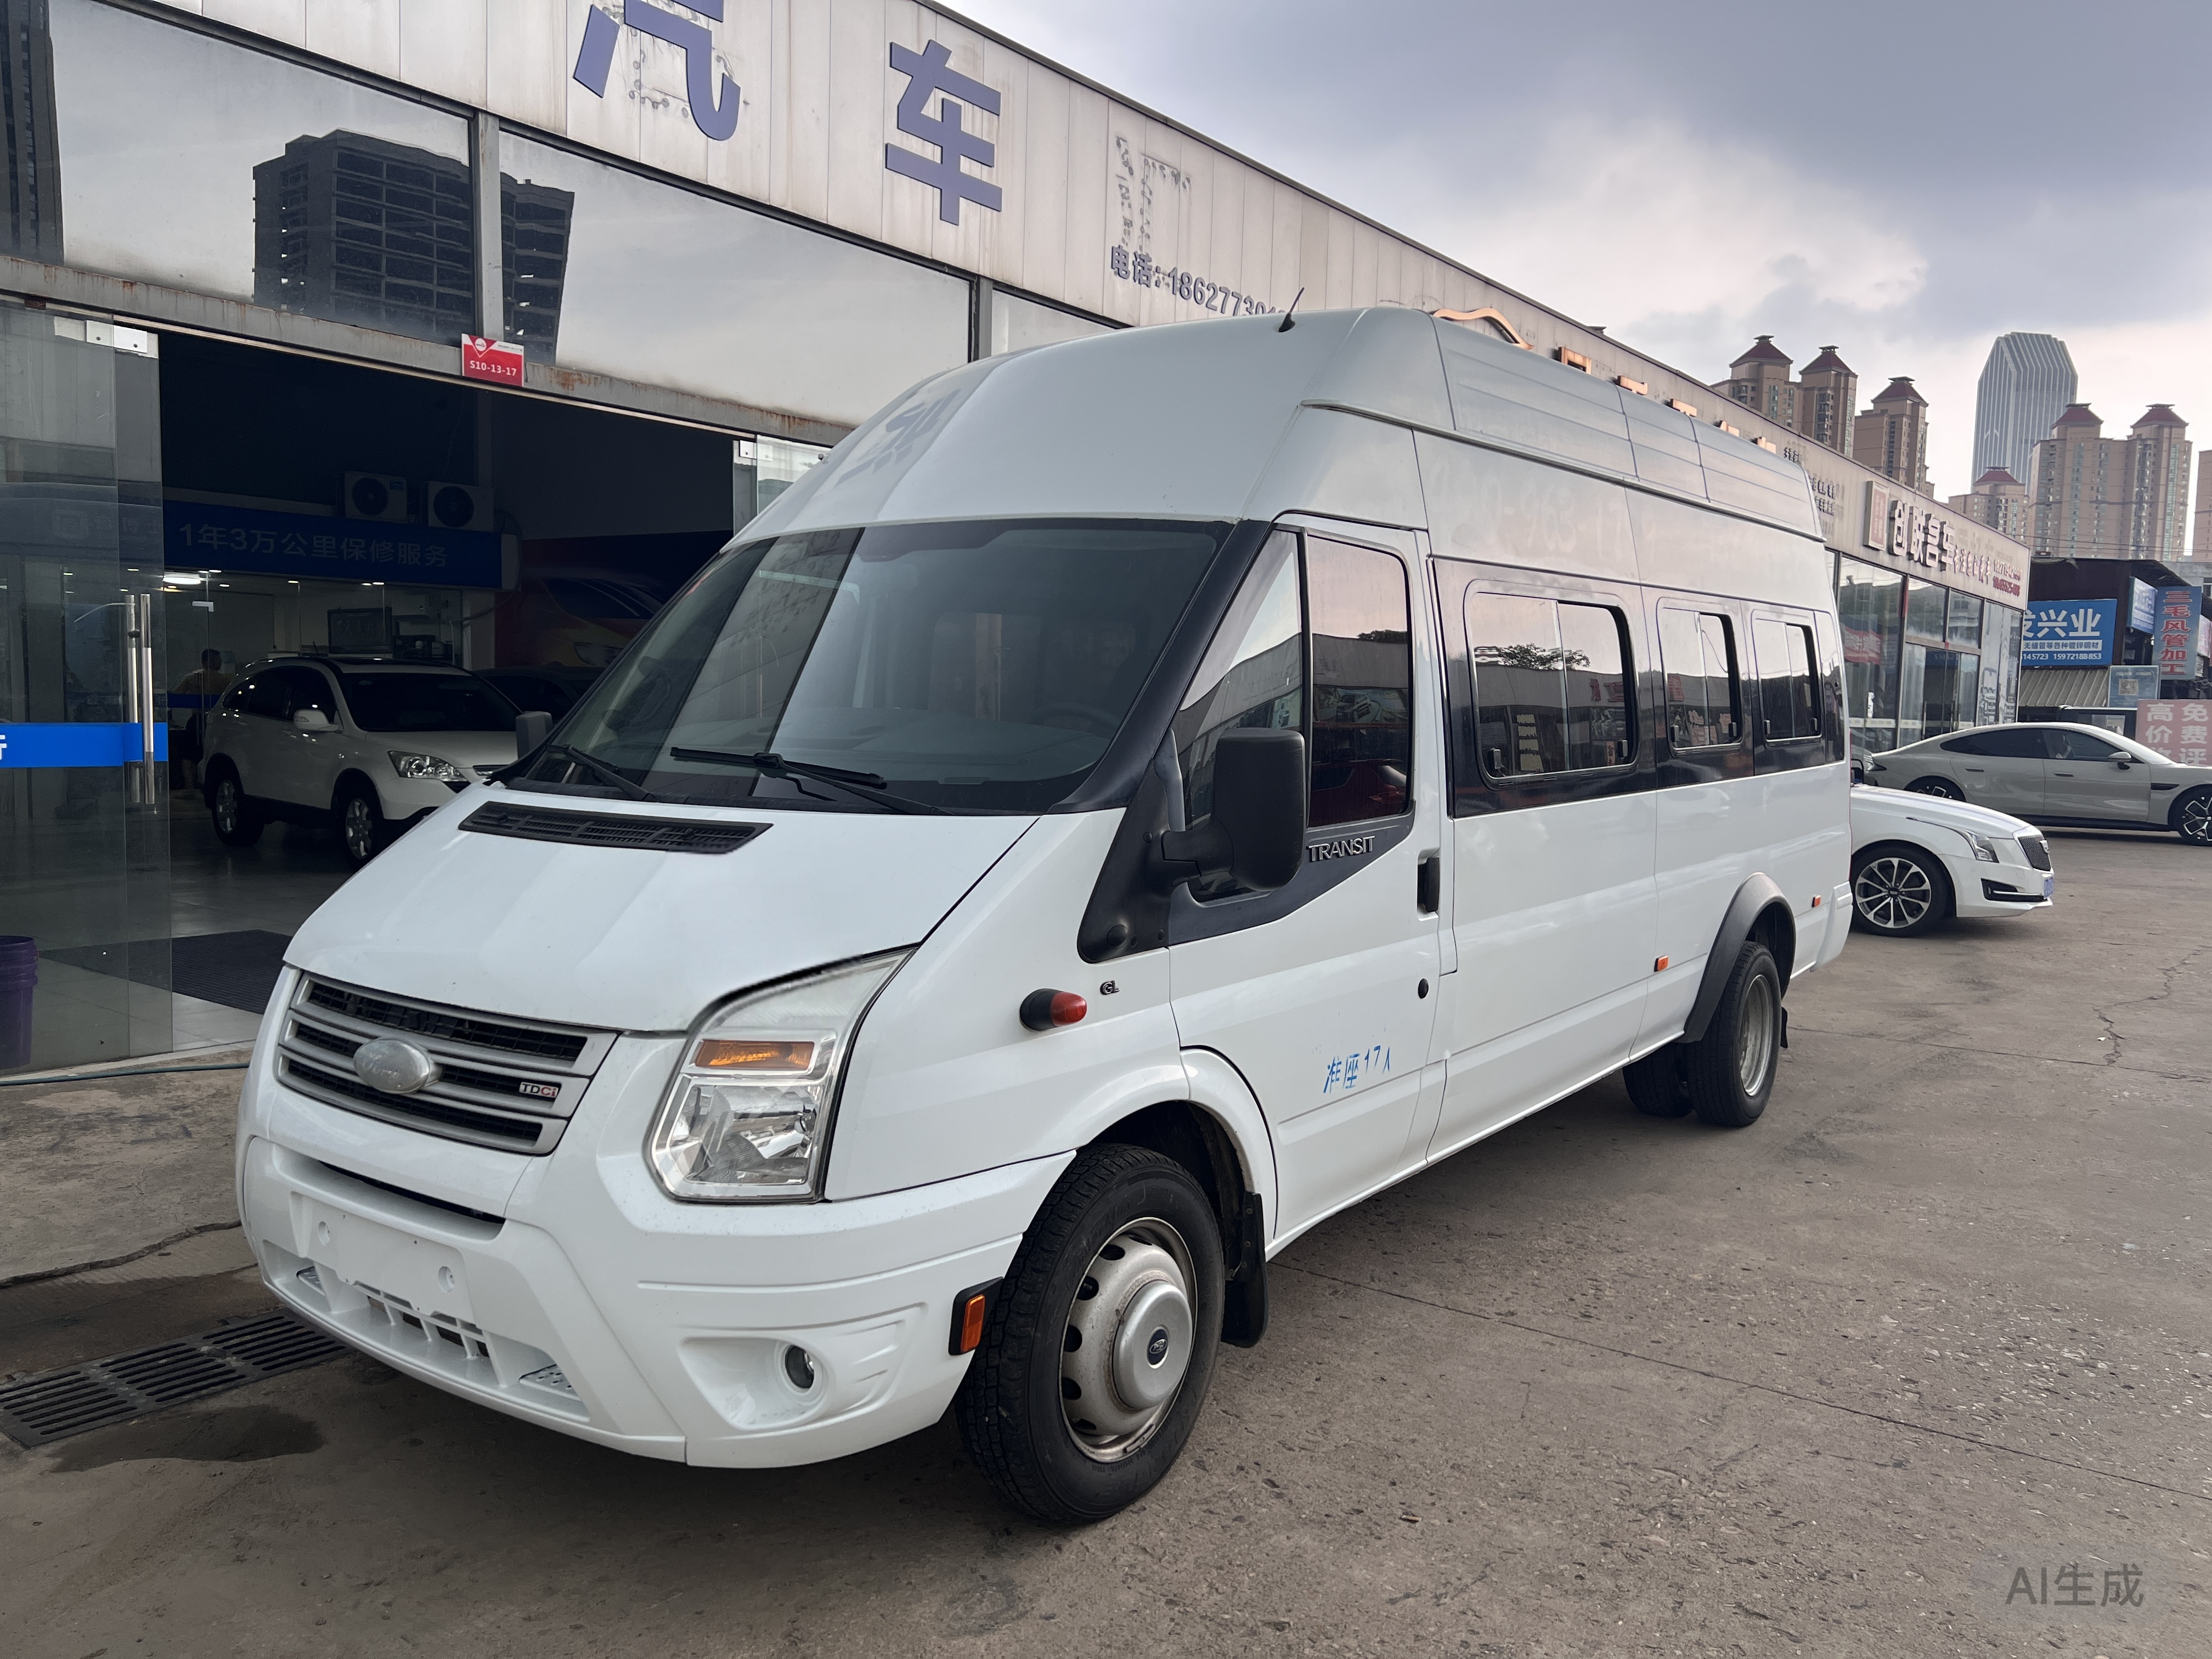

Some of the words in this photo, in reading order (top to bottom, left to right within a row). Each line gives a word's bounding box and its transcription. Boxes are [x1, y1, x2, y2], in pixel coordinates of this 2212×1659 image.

[470, 360, 517, 376] S10-13-17
[179, 522, 449, 568] 1年3万公里保修服务
[2160, 590, 2193, 675] 三毛风管加工
[2145, 703, 2175, 758] 高价
[1307, 836, 1375, 862] TRANSIT
[521, 1082, 558, 1098] TDCi
